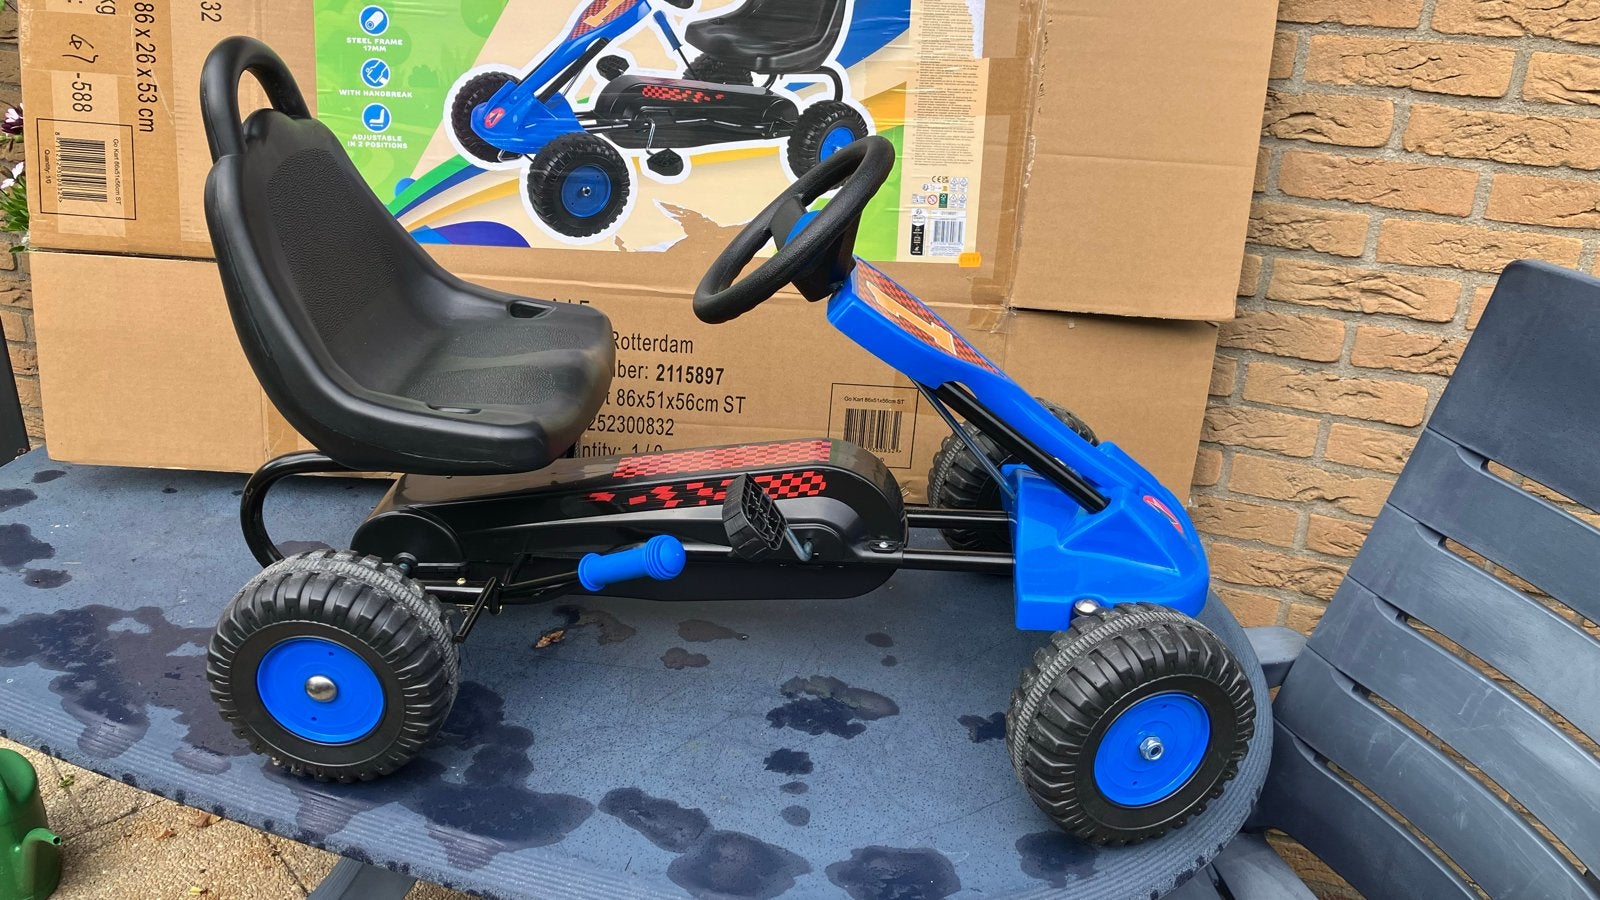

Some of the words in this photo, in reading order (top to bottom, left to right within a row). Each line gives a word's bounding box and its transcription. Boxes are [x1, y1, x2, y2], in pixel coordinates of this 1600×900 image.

[134, 2, 155, 24] 86
[200, 1, 222, 22] 32
[135, 28, 151, 38] x
[374, 38, 403, 46] FRAME
[136, 42, 156, 64] 26
[137, 68, 152, 77] x
[137, 82, 158, 103] 53
[339, 89, 360, 97] WITH
[138, 108, 154, 132] cm
[352, 134, 402, 142] ADJUSTABLE
[365, 141, 407, 149] POSITIONS
[656, 363, 724, 385] 2115897
[616, 388, 718, 413] 86x51x56cm
[723, 395, 746, 413] ST
